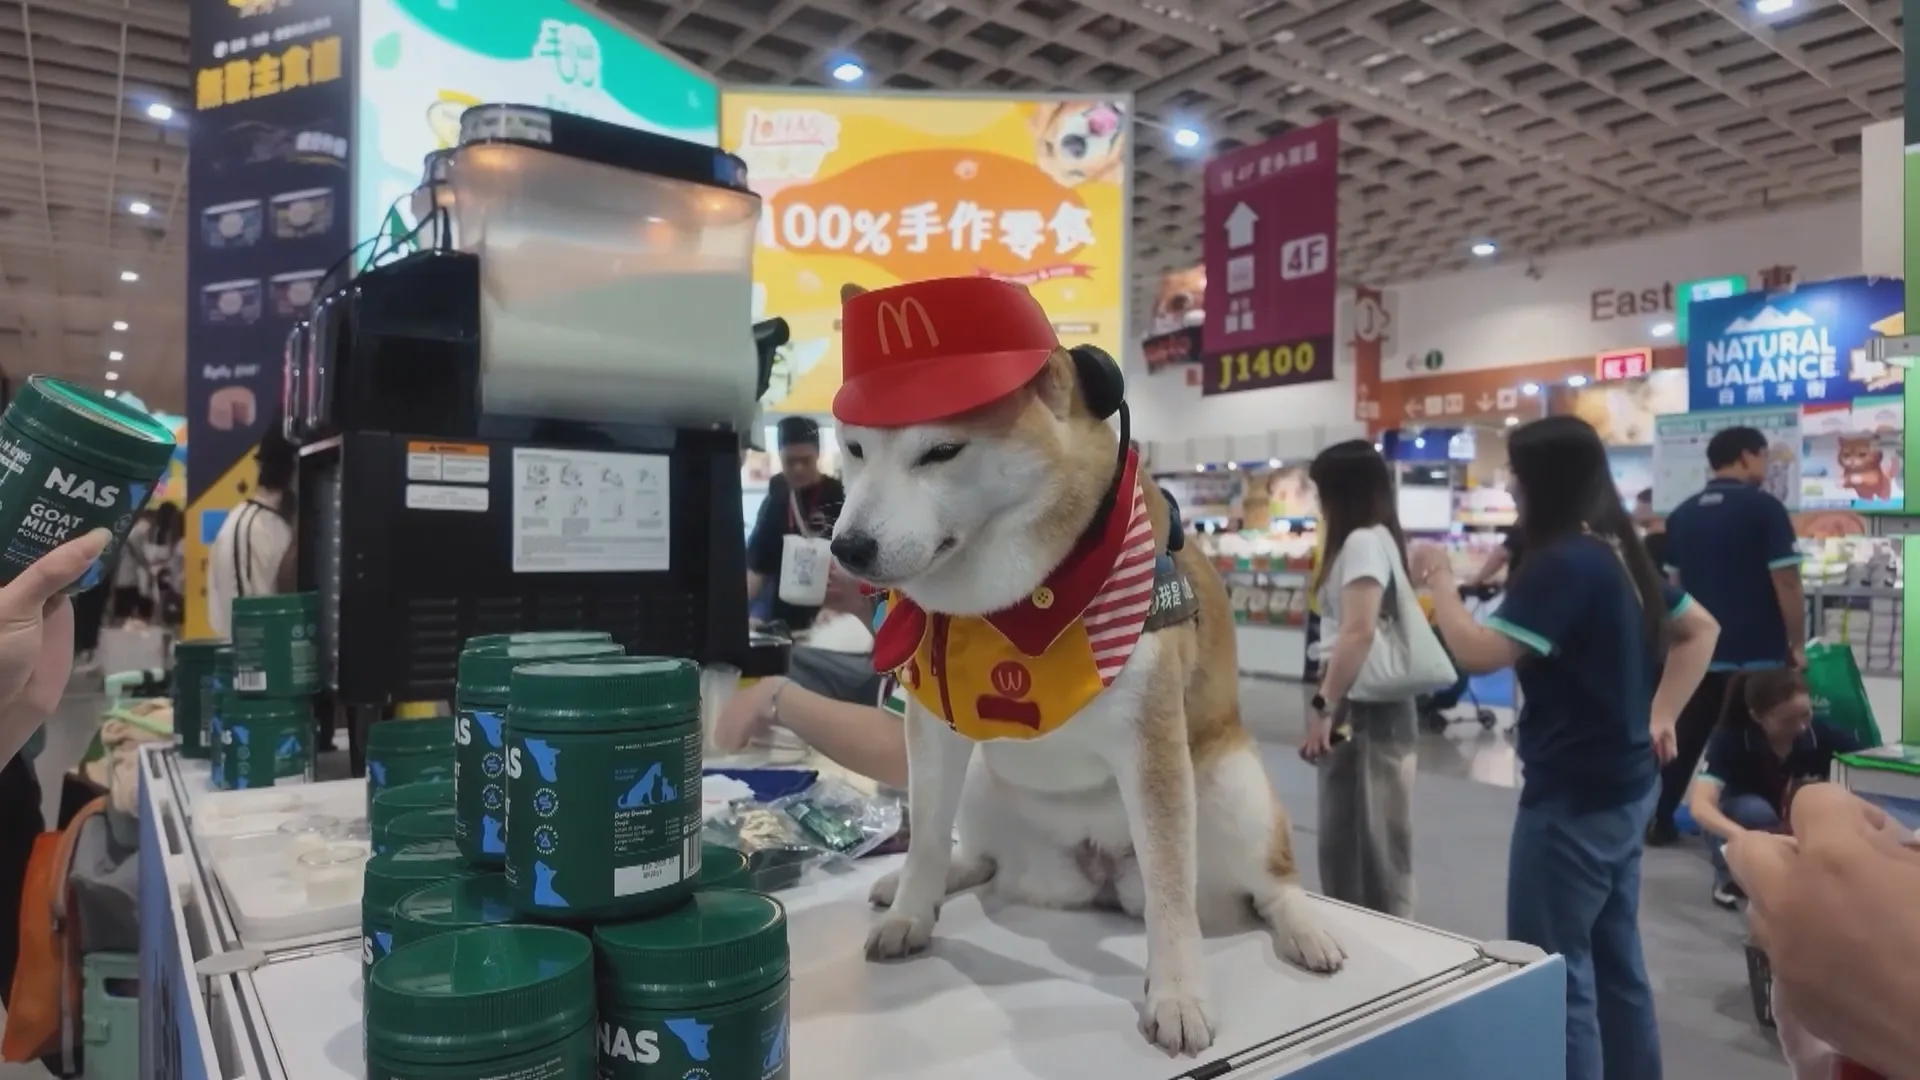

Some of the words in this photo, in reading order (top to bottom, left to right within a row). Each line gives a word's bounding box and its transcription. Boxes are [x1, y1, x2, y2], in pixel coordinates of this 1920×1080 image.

[1286, 238, 1323, 274] 4F
[1590, 281, 1674, 321] East
[1706, 327, 1837, 365] NATURAL
[1217, 341, 1316, 390] J1400
[1706, 354, 1838, 389] BALANCE
[44, 466, 120, 508] NAS
[22, 515, 69, 540] MILK
[30, 503, 84, 529] GOAT
[17, 527, 59, 547] POWDER
